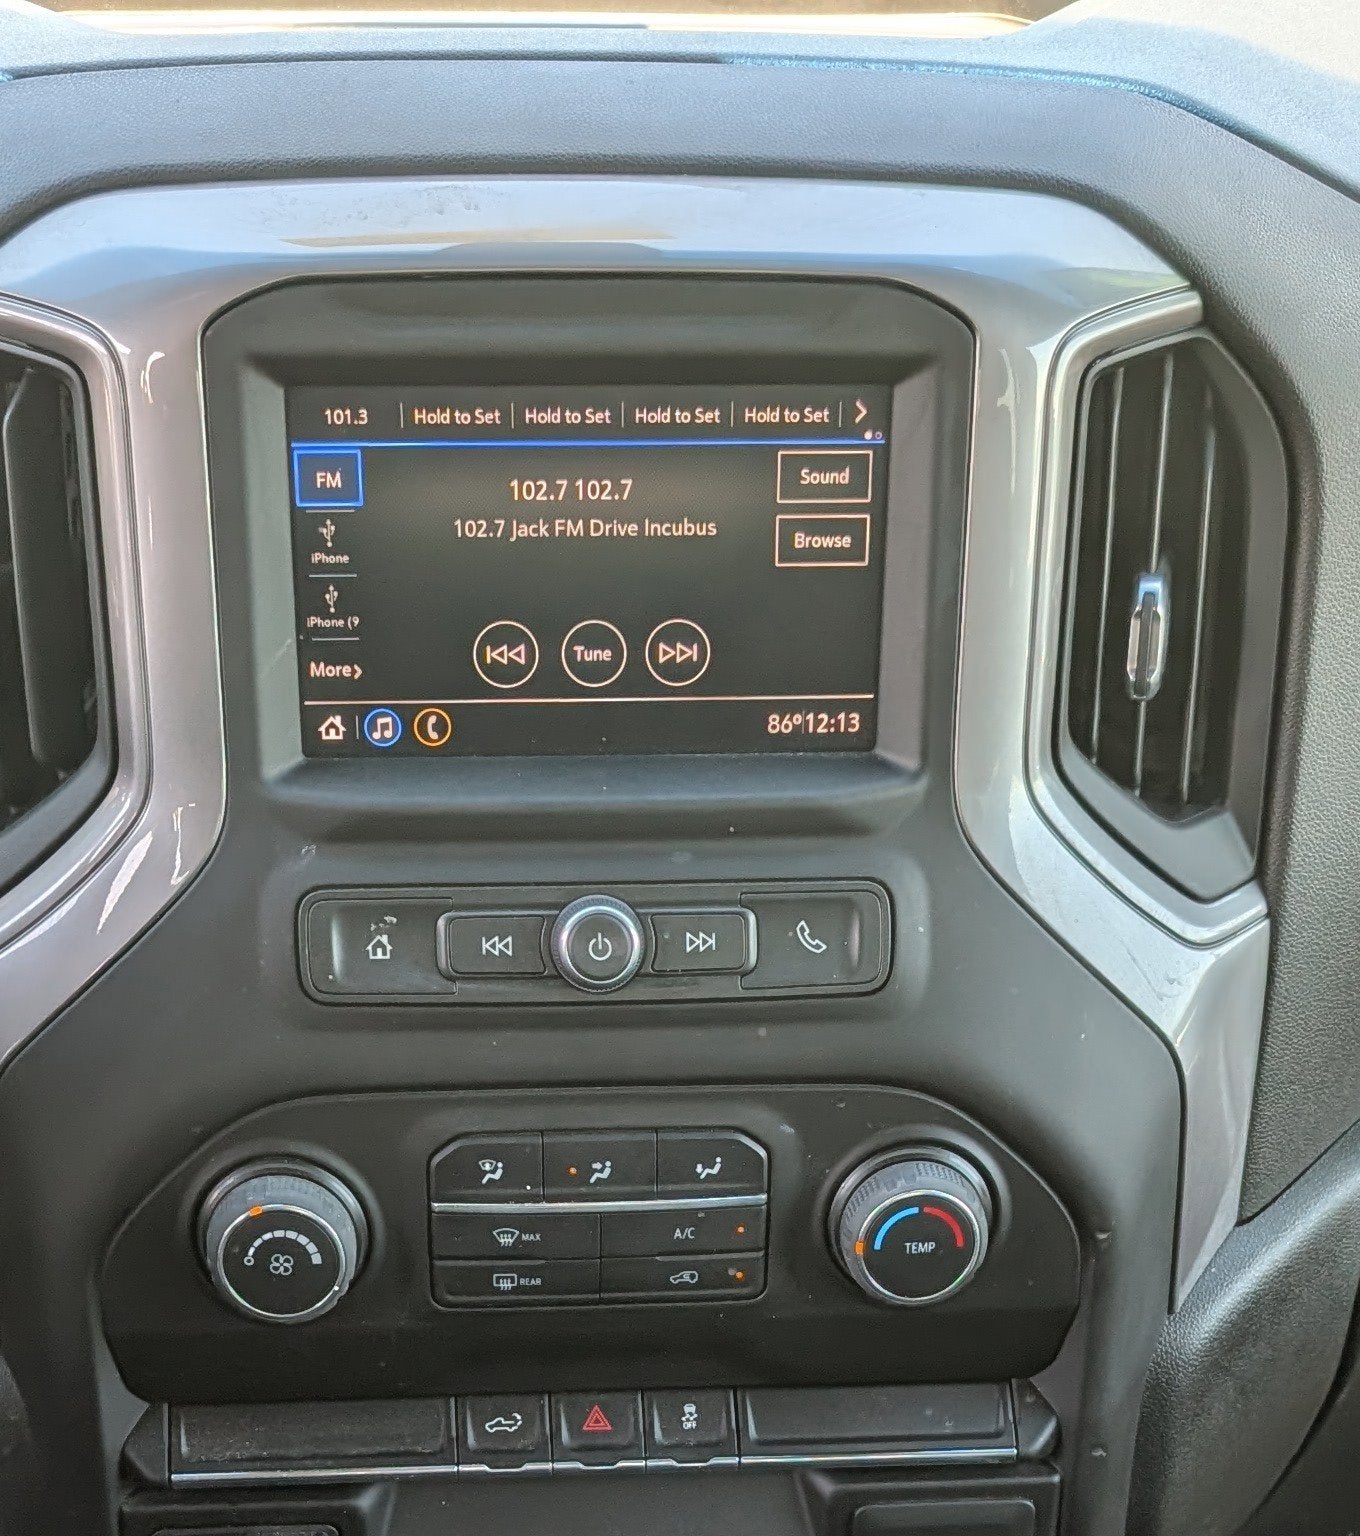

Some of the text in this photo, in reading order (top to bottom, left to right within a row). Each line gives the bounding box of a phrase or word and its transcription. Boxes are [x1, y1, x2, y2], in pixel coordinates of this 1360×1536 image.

[324, 408, 369, 426] 101.3
[413, 407, 502, 425] Hold to Set
[524, 407, 612, 425] Hold to Set
[635, 406, 721, 424] Hold to Set
[744, 406, 830, 424] Hold to Set
[315, 470, 342, 489] FM
[799, 465, 850, 486] Sound
[509, 479, 634, 501] 102.7 102.7
[453, 517, 718, 543] 102.7 Jack FM Drive Incubus
[794, 531, 852, 549] Browse
[310, 552, 350, 565] iPhone
[306, 616, 360, 631] iPhone (9
[572, 645, 613, 662] Tune
[805, 711, 861, 734] 12:13
[521, 1232, 542, 1242] MAX
[673, 1227, 696, 1240] A/C
[904, 1241, 936, 1254] TEMP
[519, 1277, 542, 1286] REAR
